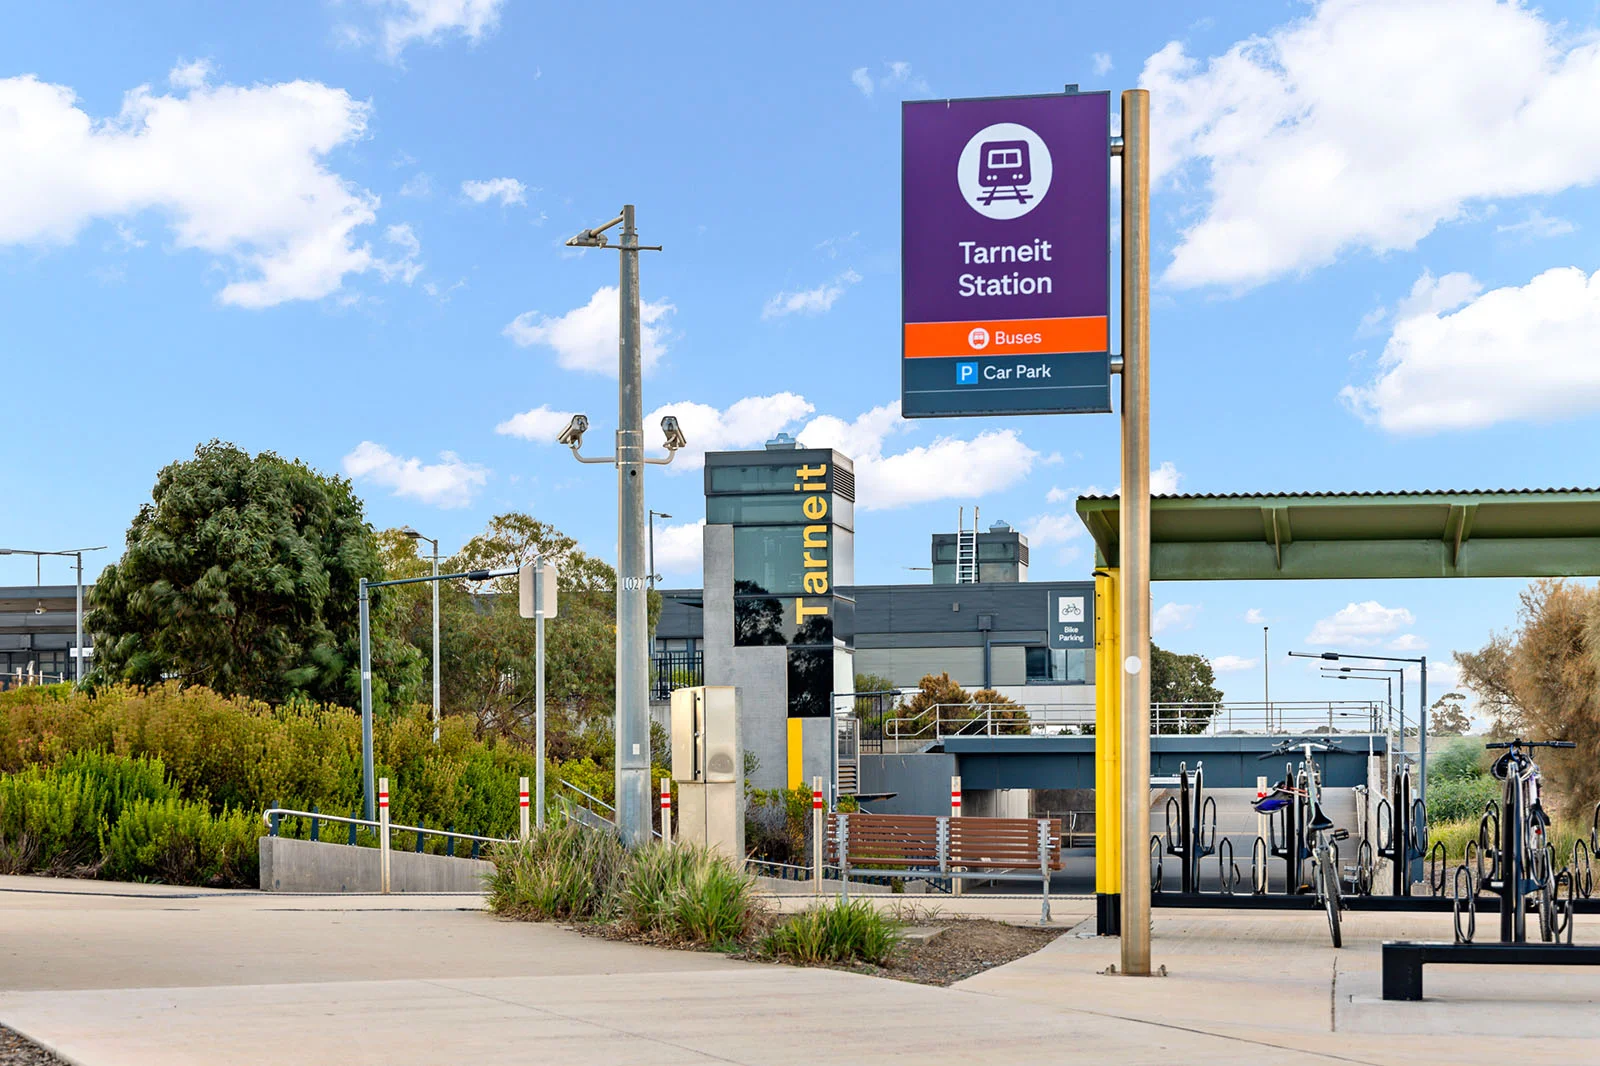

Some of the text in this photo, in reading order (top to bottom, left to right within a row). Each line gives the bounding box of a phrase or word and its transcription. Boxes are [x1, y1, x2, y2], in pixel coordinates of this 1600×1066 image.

[959, 238, 1052, 265] Tarneit
[959, 272, 1052, 297] Station
[995, 331, 1042, 345] Buses
[961, 364, 1052, 381] P Car Park
[794, 463, 829, 625] Tarneit
[1058, 634, 1084, 643] Parking
